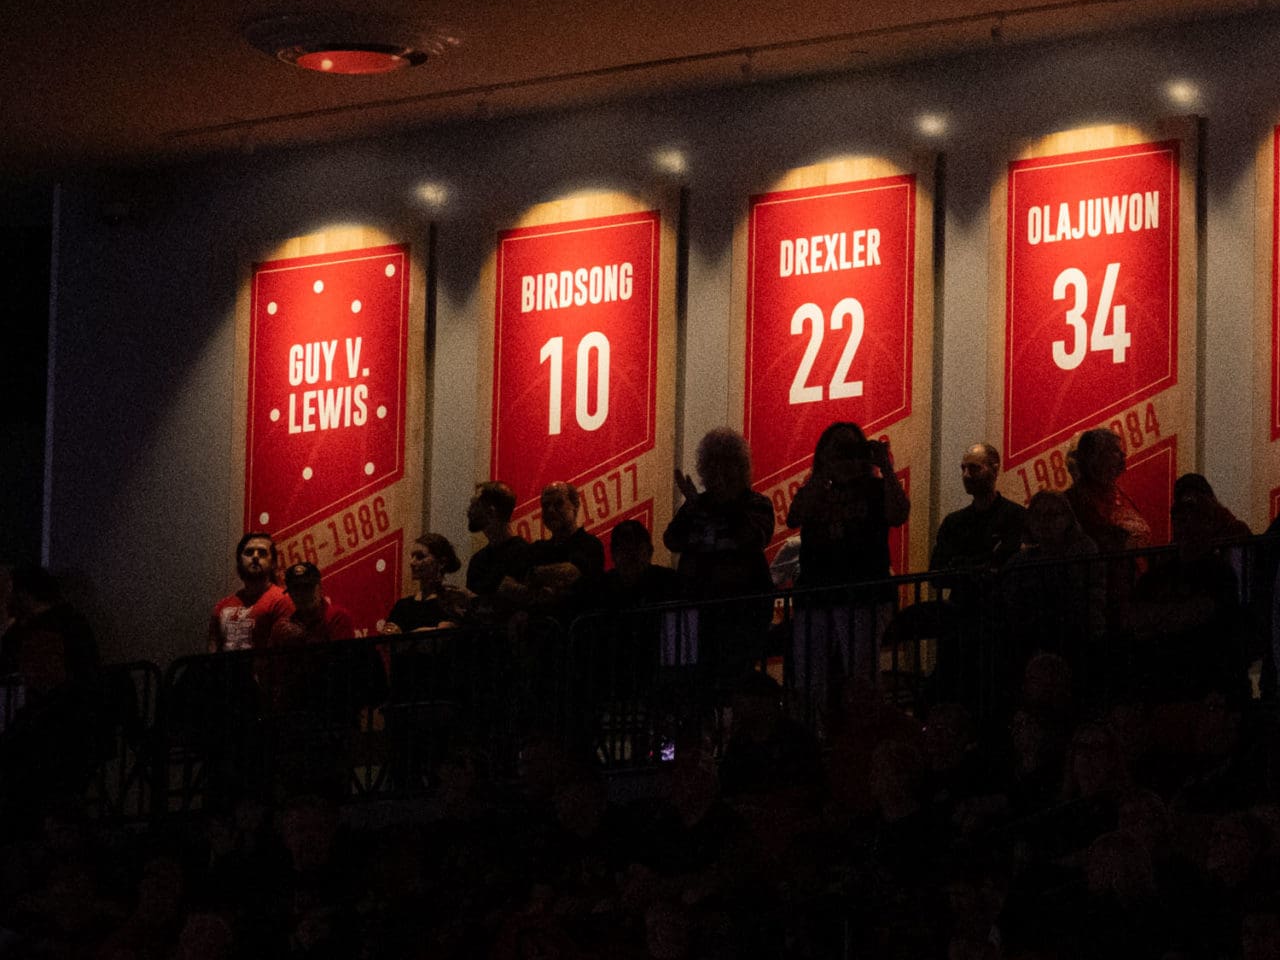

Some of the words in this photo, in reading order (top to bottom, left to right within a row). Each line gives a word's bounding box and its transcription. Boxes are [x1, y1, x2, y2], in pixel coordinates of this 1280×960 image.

[1027, 191, 1160, 245] OLAJUWON
[779, 228, 881, 278] DREXLER
[521, 262, 633, 313] BIRDSONG
[1052, 262, 1131, 370] 34
[288, 340, 338, 386] GUY
[346, 337, 370, 379] V.
[789, 297, 865, 405] 22
[539, 330, 611, 435] 10
[288, 384, 369, 434] LEWIS
